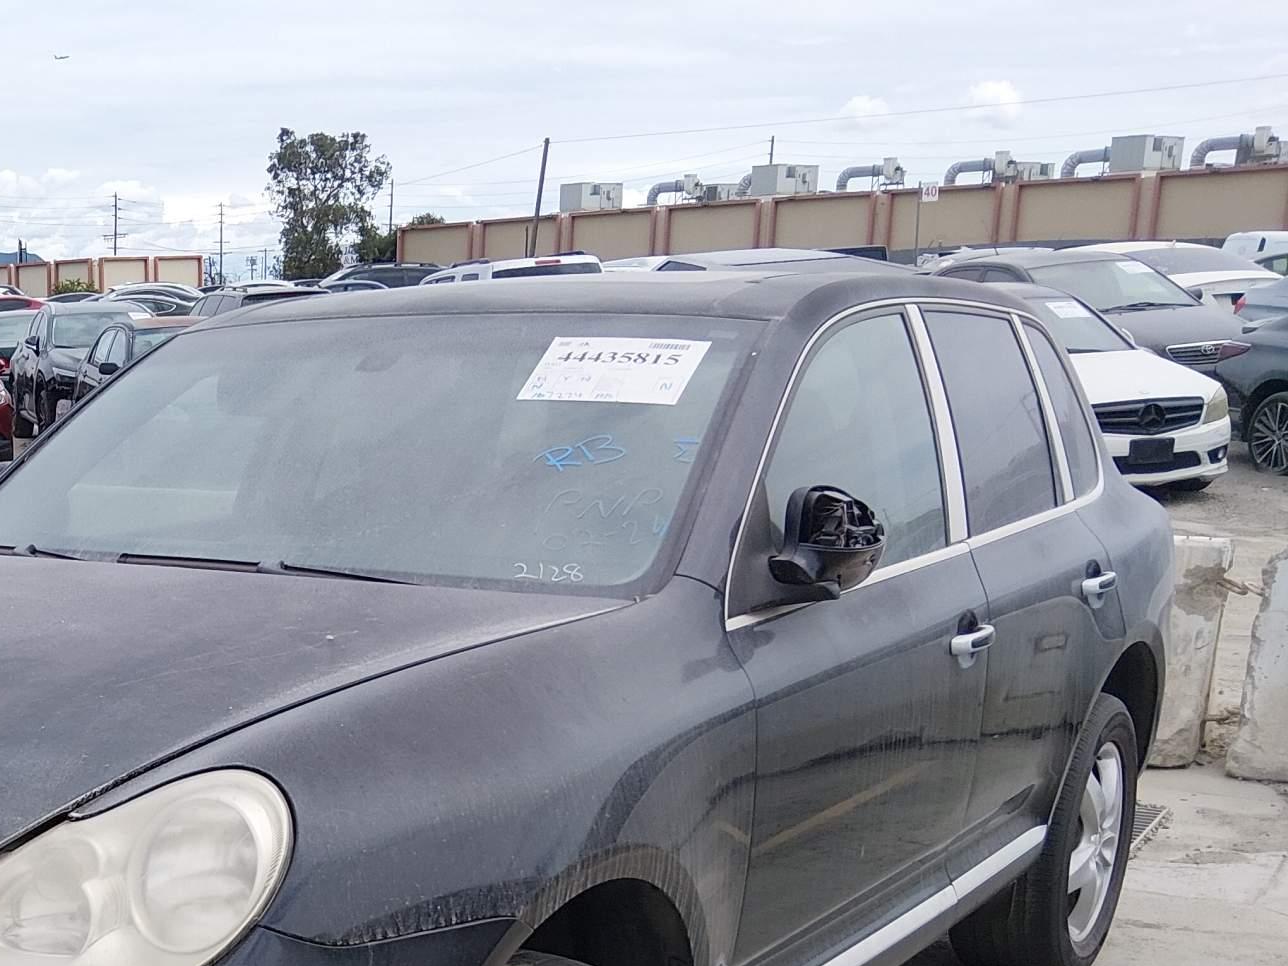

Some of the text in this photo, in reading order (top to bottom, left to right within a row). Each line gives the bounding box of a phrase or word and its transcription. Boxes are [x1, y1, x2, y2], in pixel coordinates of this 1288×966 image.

[924, 186, 937, 197] 40
[557, 350, 683, 366] 44435815
[513, 561, 585, 583] 2128
